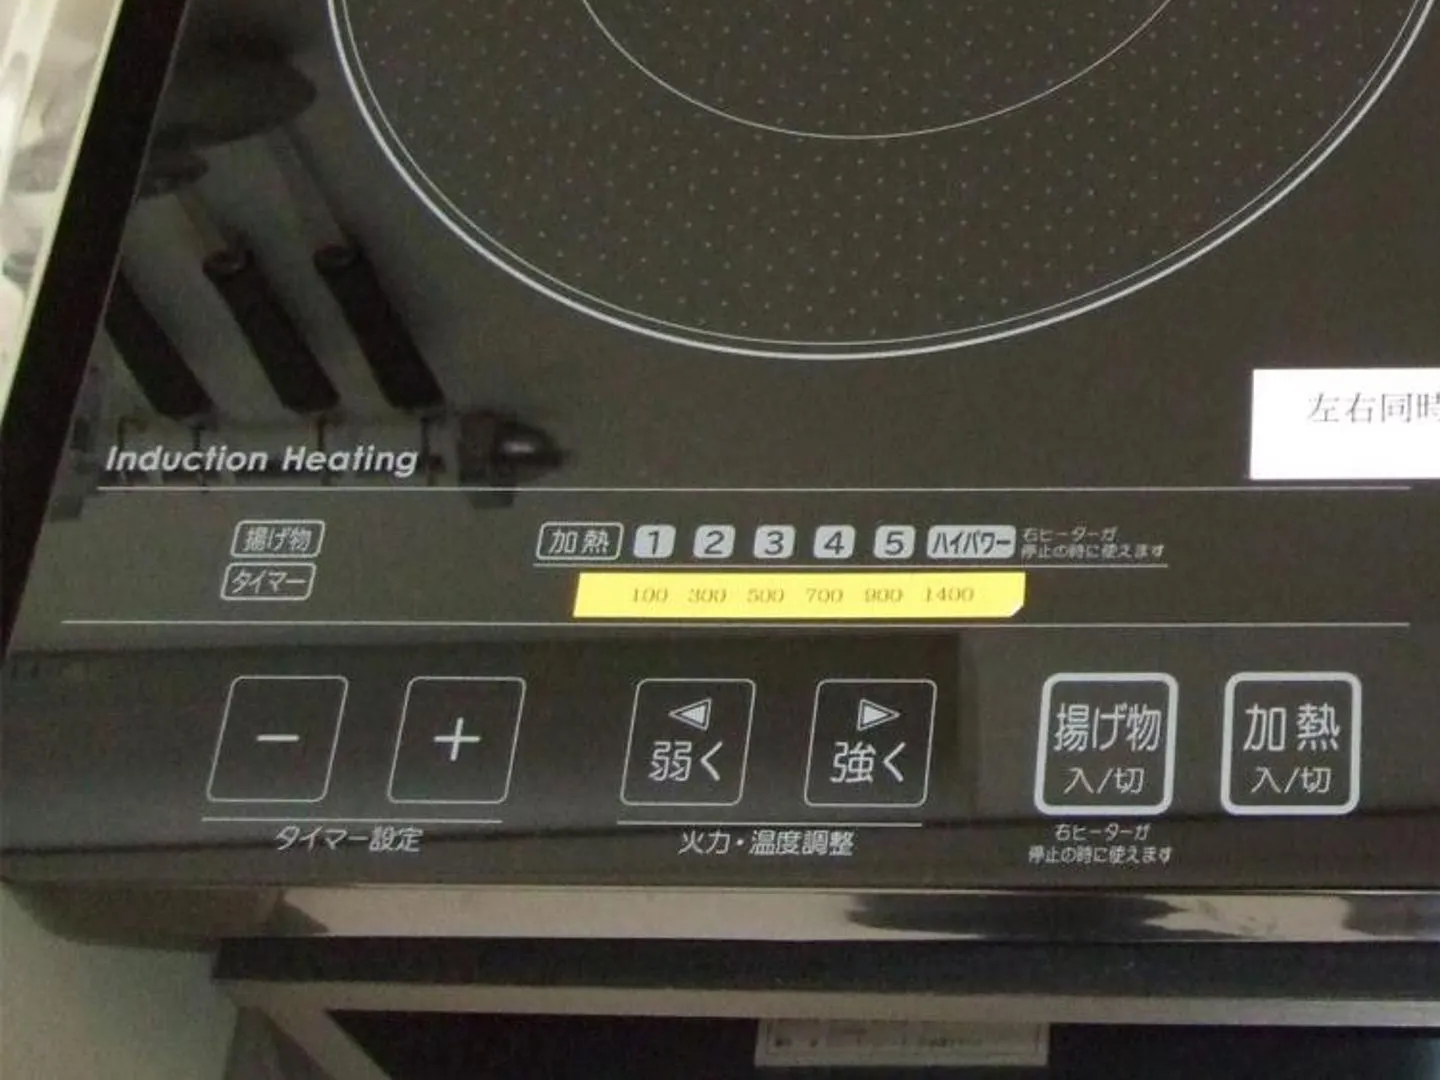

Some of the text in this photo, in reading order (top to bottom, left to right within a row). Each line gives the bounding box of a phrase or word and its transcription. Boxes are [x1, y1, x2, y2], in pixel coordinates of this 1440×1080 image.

[105, 445, 419, 478] Induction Heating
[242, 526, 313, 553] 揚げ物
[549, 527, 610, 555] 加熱
[704, 530, 726, 554] 2
[764, 530, 785, 555] 3
[823, 530, 845, 555] 4
[884, 530, 905, 555] 5
[931, 530, 1012, 555] ハイパワー
[231, 569, 307, 594] タイマー
[631, 587, 669, 603] 100
[687, 587, 728, 603] 300
[746, 587, 785, 603] 500
[805, 587, 844, 603] 700
[924, 587, 975, 603] 1400
[1053, 701, 1162, 753] 揚げ物
[1243, 701, 1341, 753] 加熱
[648, 740, 724, 782] 弱く
[829, 740, 907, 784] 強く
[1063, 766, 1146, 795] 入/切
[1251, 766, 1332, 795] 入/切
[273, 824, 424, 854] タイマー設定
[677, 829, 858, 857] 火力・温度調整
[1054, 822, 1151, 842] 右ヒーターが
